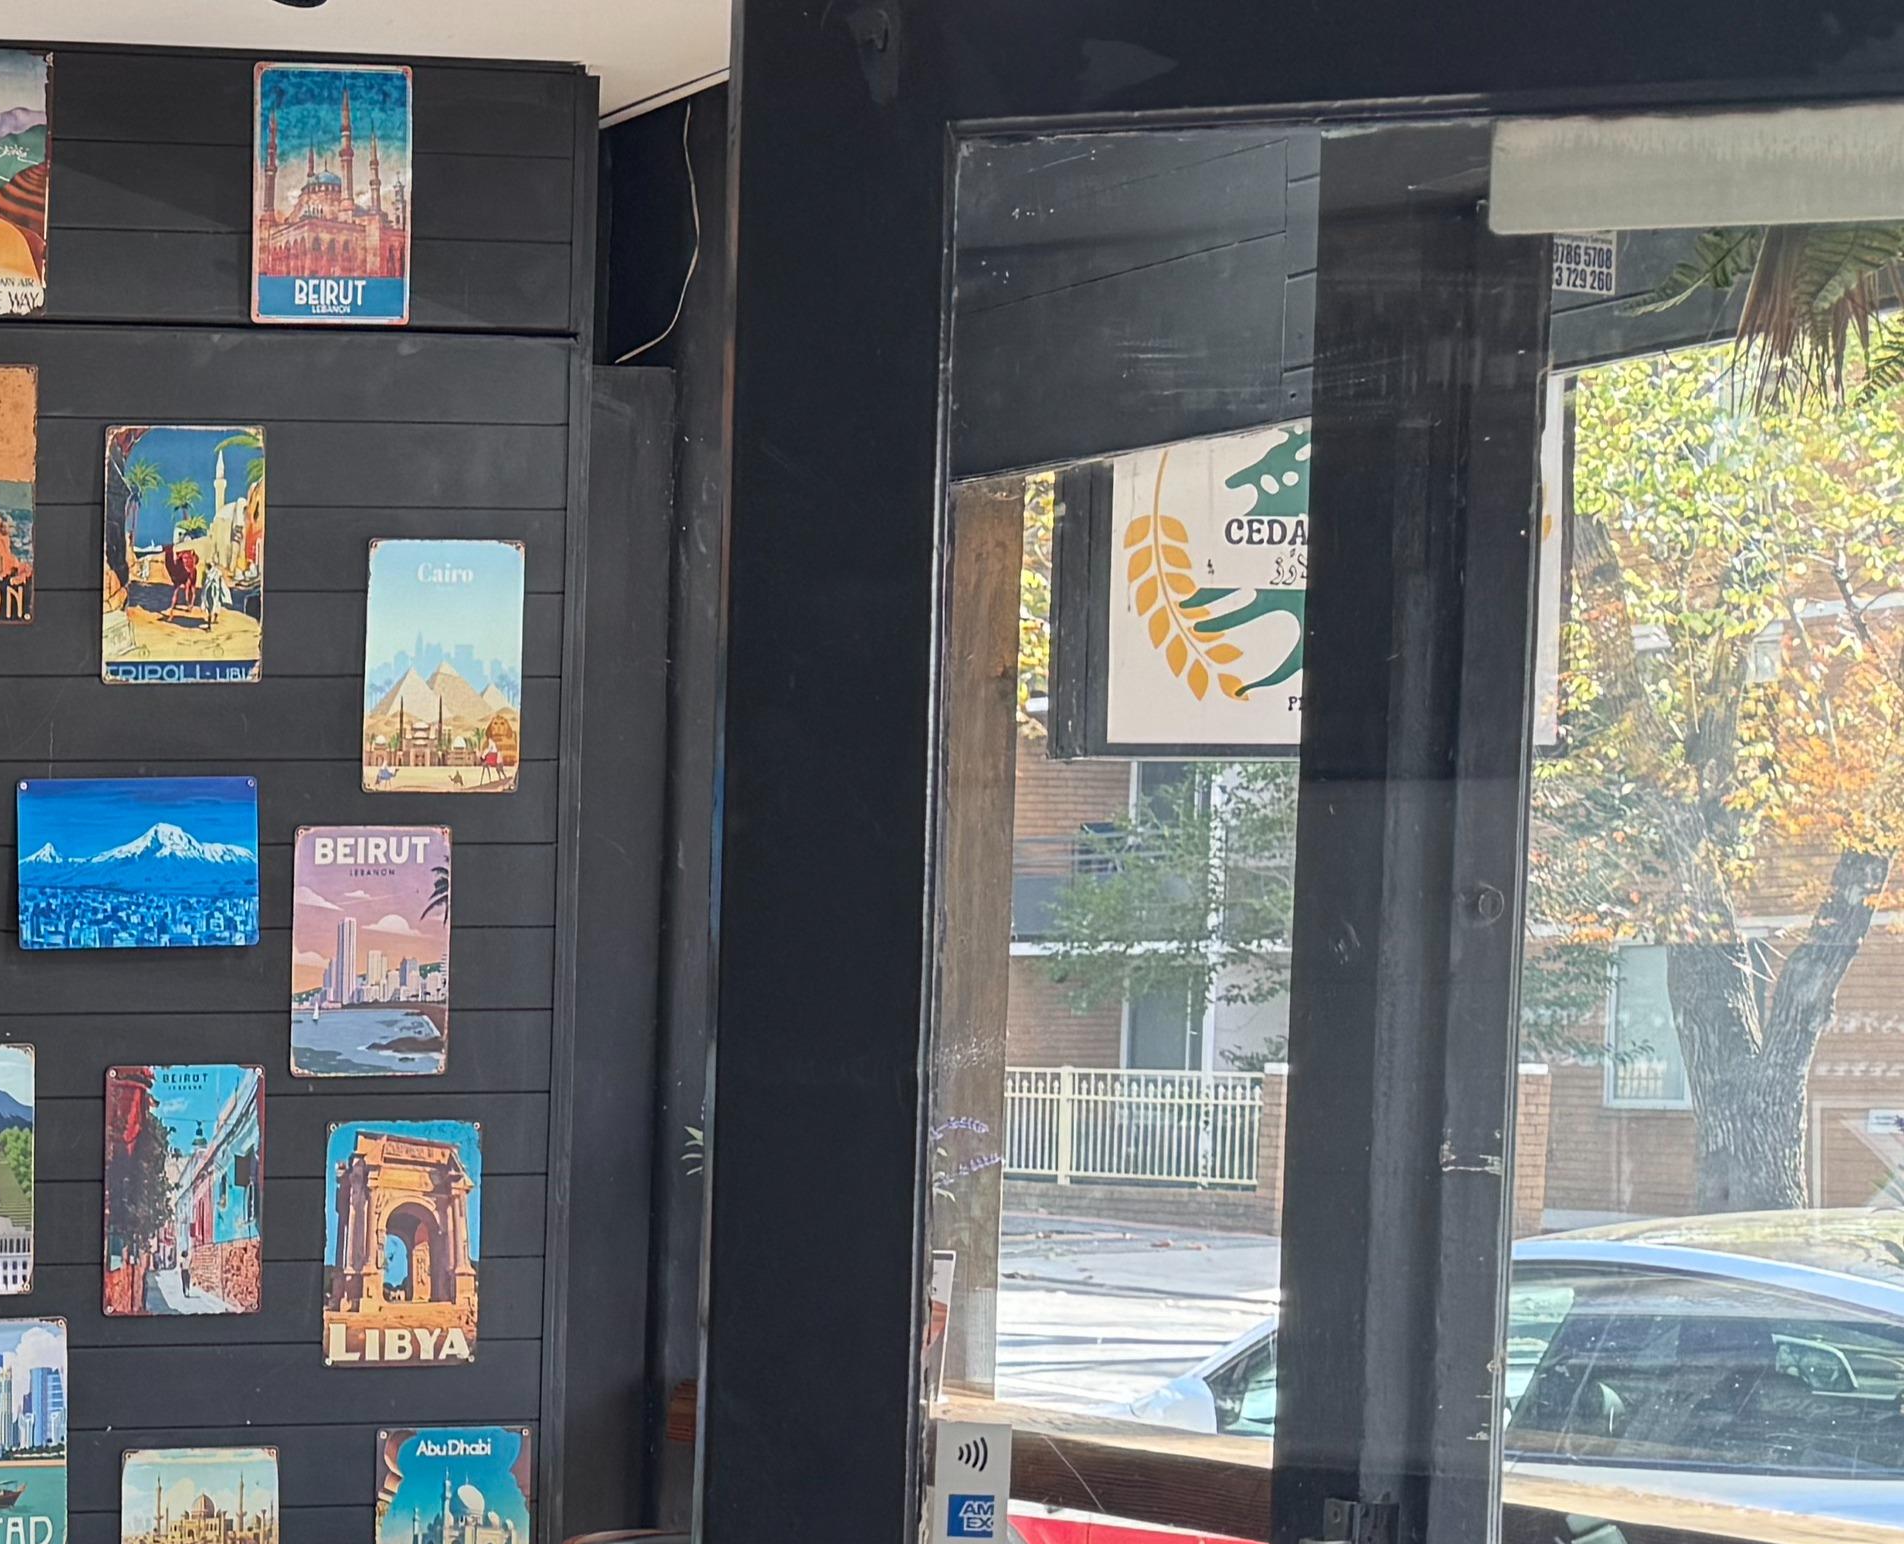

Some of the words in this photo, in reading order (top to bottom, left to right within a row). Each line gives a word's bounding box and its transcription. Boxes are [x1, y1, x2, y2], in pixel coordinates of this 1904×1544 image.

[1584, 246, 1613, 270] 5708
[1566, 267, 1587, 288] 729
[1589, 270, 1612, 292] 260
[7, 291, 40, 311] WAY
[294, 279, 367, 306] BEIRUT
[312, 305, 351, 314] LEBANON
[1225, 518, 1309, 546] CEDA
[416, 562, 473, 583] Cairo
[314, 836, 430, 865] BEIRUT
[350, 868, 395, 877] LEBANON
[162, 1073, 208, 1083] BEIRUT
[328, 1321, 471, 1362] LIBYA
[415, 1438, 448, 1457] Abu
[448, 1438, 492, 1457] Dhabi
[961, 1502, 994, 1516] AM
